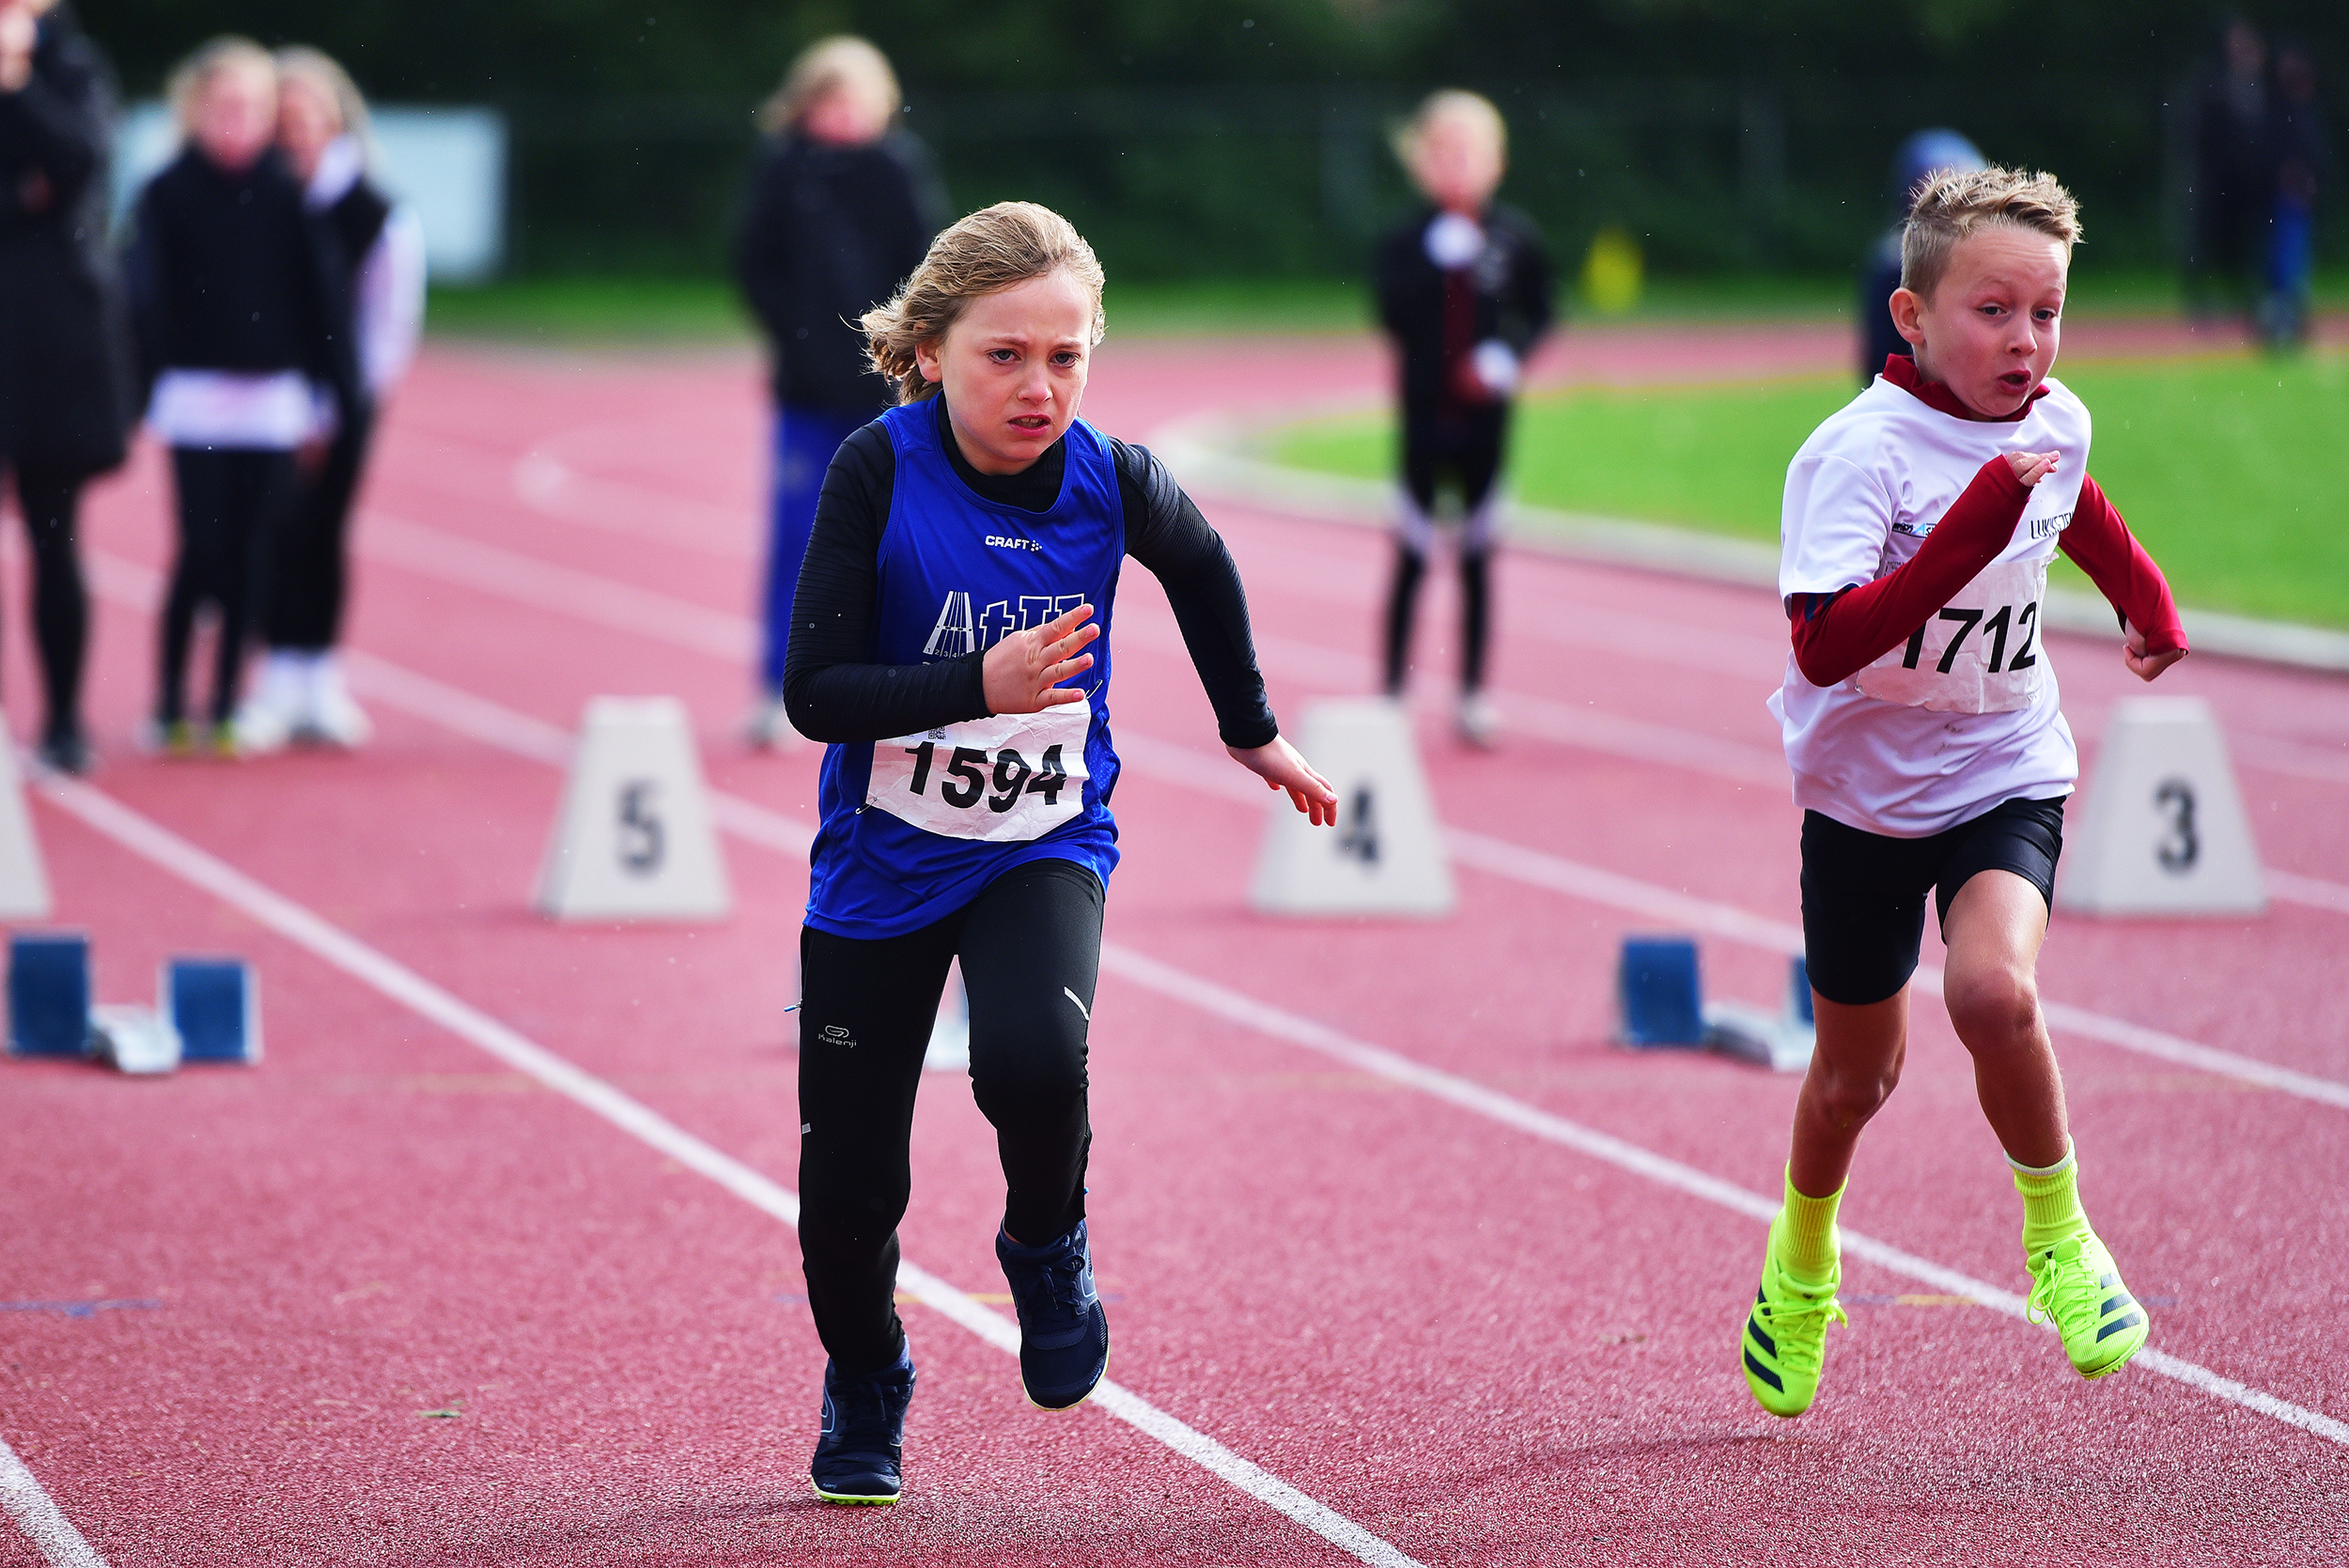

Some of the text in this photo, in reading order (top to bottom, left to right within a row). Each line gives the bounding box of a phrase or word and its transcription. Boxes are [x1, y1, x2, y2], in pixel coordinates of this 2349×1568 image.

[985, 535, 1030, 551] CRAFT
[1901, 601, 2037, 675] 1712
[904, 740, 1067, 814] 1594
[616, 778, 666, 878] 5
[1334, 782, 1382, 868] 4
[2154, 778, 2199, 877] 3
[817, 1032, 857, 1049] Kalenji
